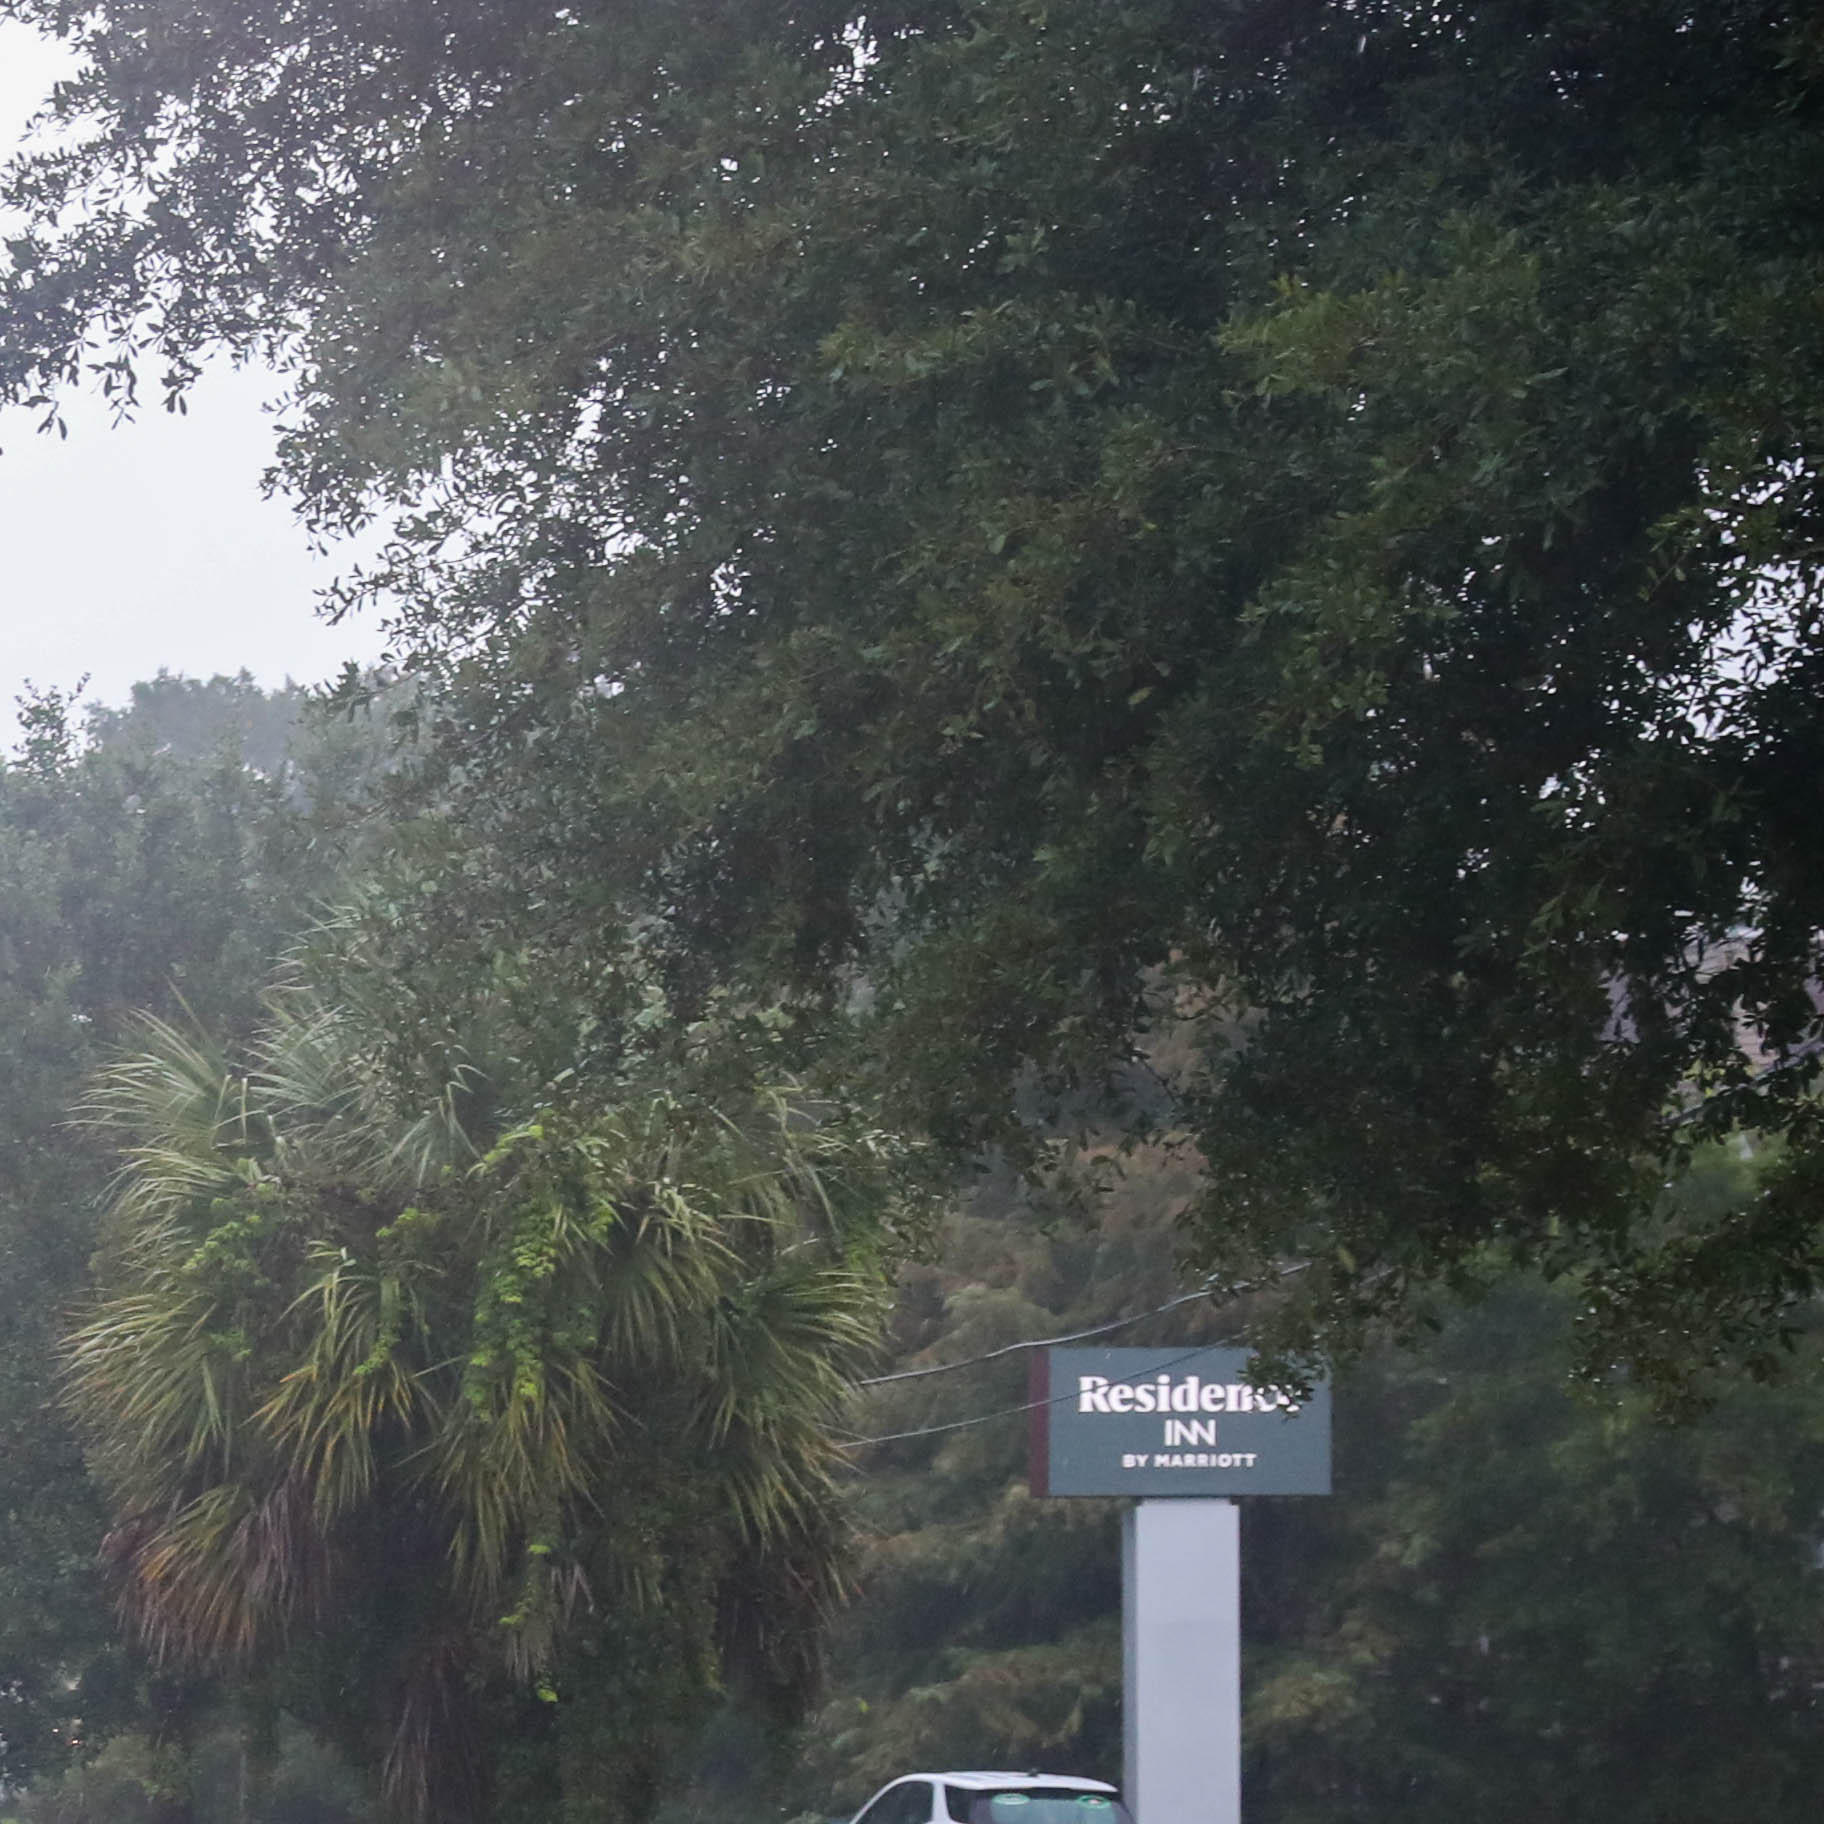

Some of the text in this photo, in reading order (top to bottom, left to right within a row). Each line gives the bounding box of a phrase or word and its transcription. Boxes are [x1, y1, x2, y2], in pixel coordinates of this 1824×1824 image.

[1163, 1418, 1217, 1447] INN
[1121, 1453, 1257, 1469] BY MARRIOTT
